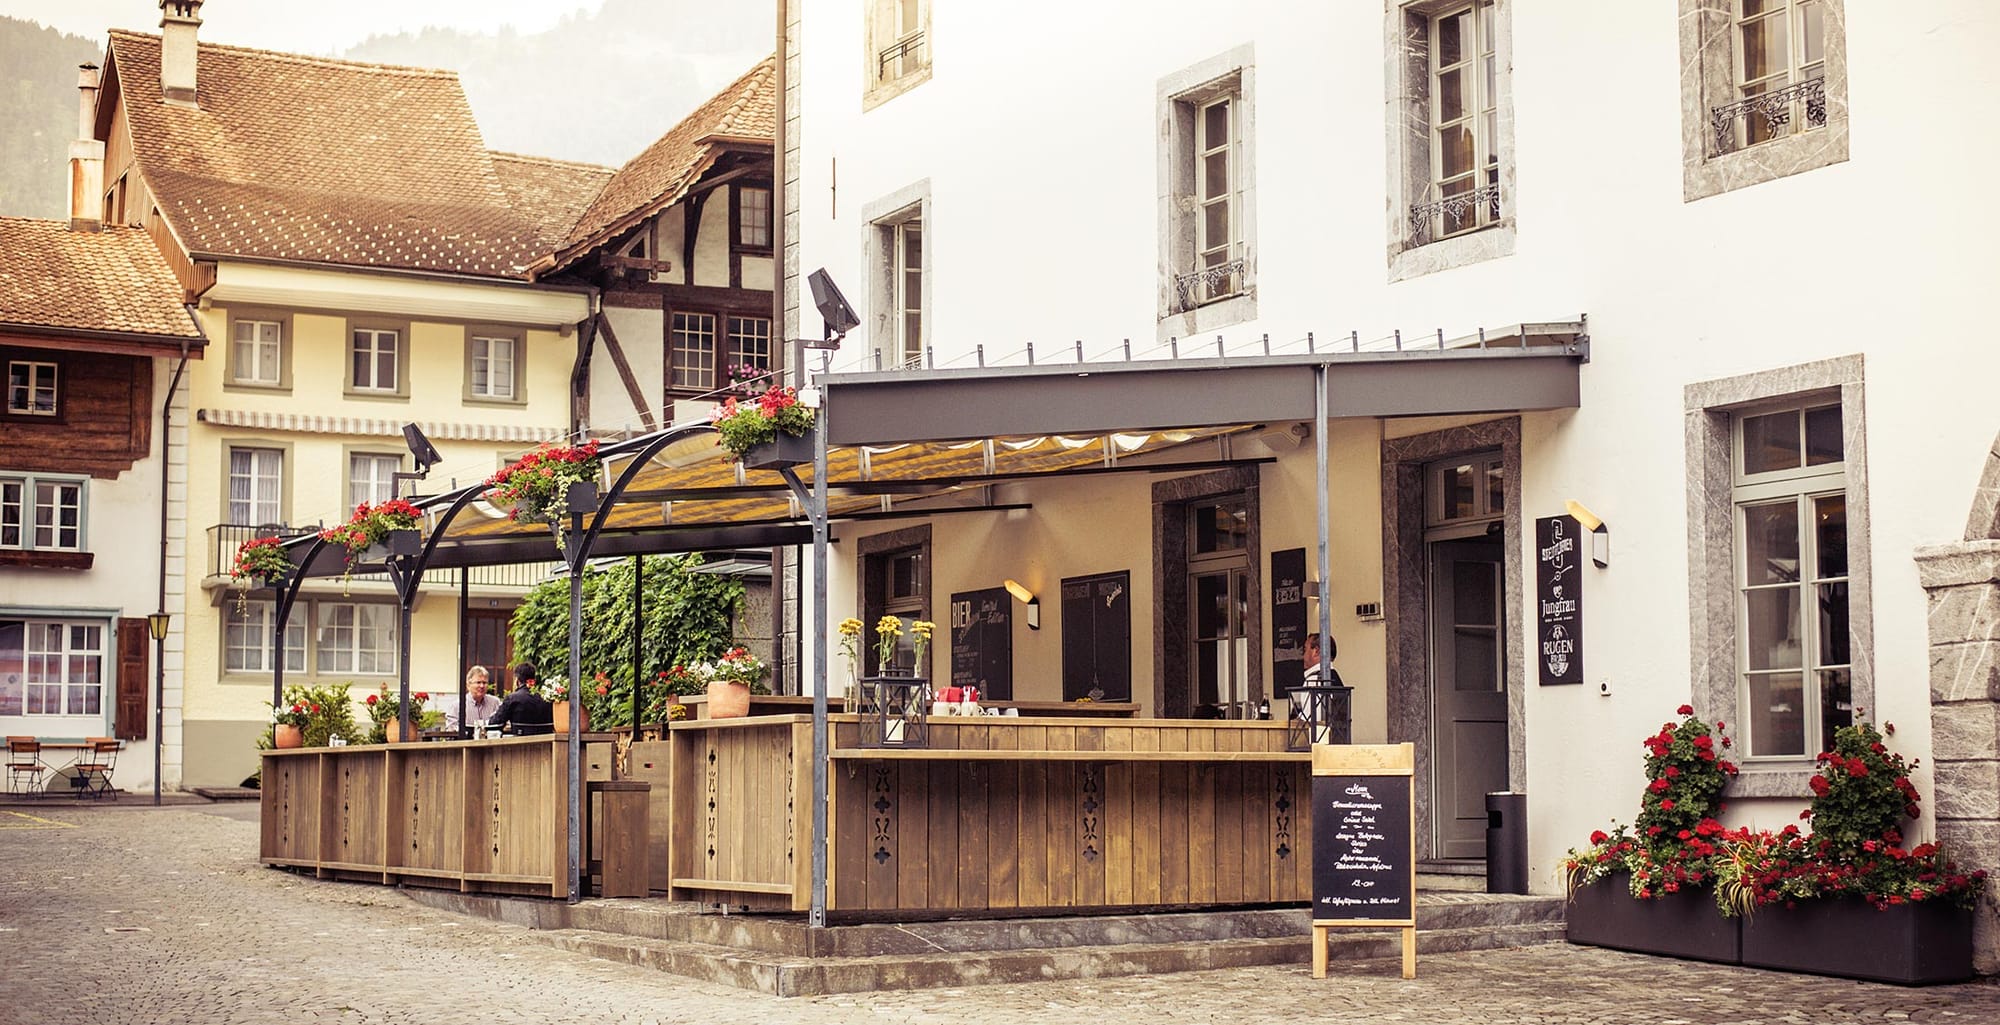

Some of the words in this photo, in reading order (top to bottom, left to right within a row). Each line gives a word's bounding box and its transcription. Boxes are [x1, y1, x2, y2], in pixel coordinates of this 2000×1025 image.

[952, 601, 972, 629] BIER
[1542, 597, 1576, 618] Jungfrau
[1543, 639, 1574, 656] RUGEN
